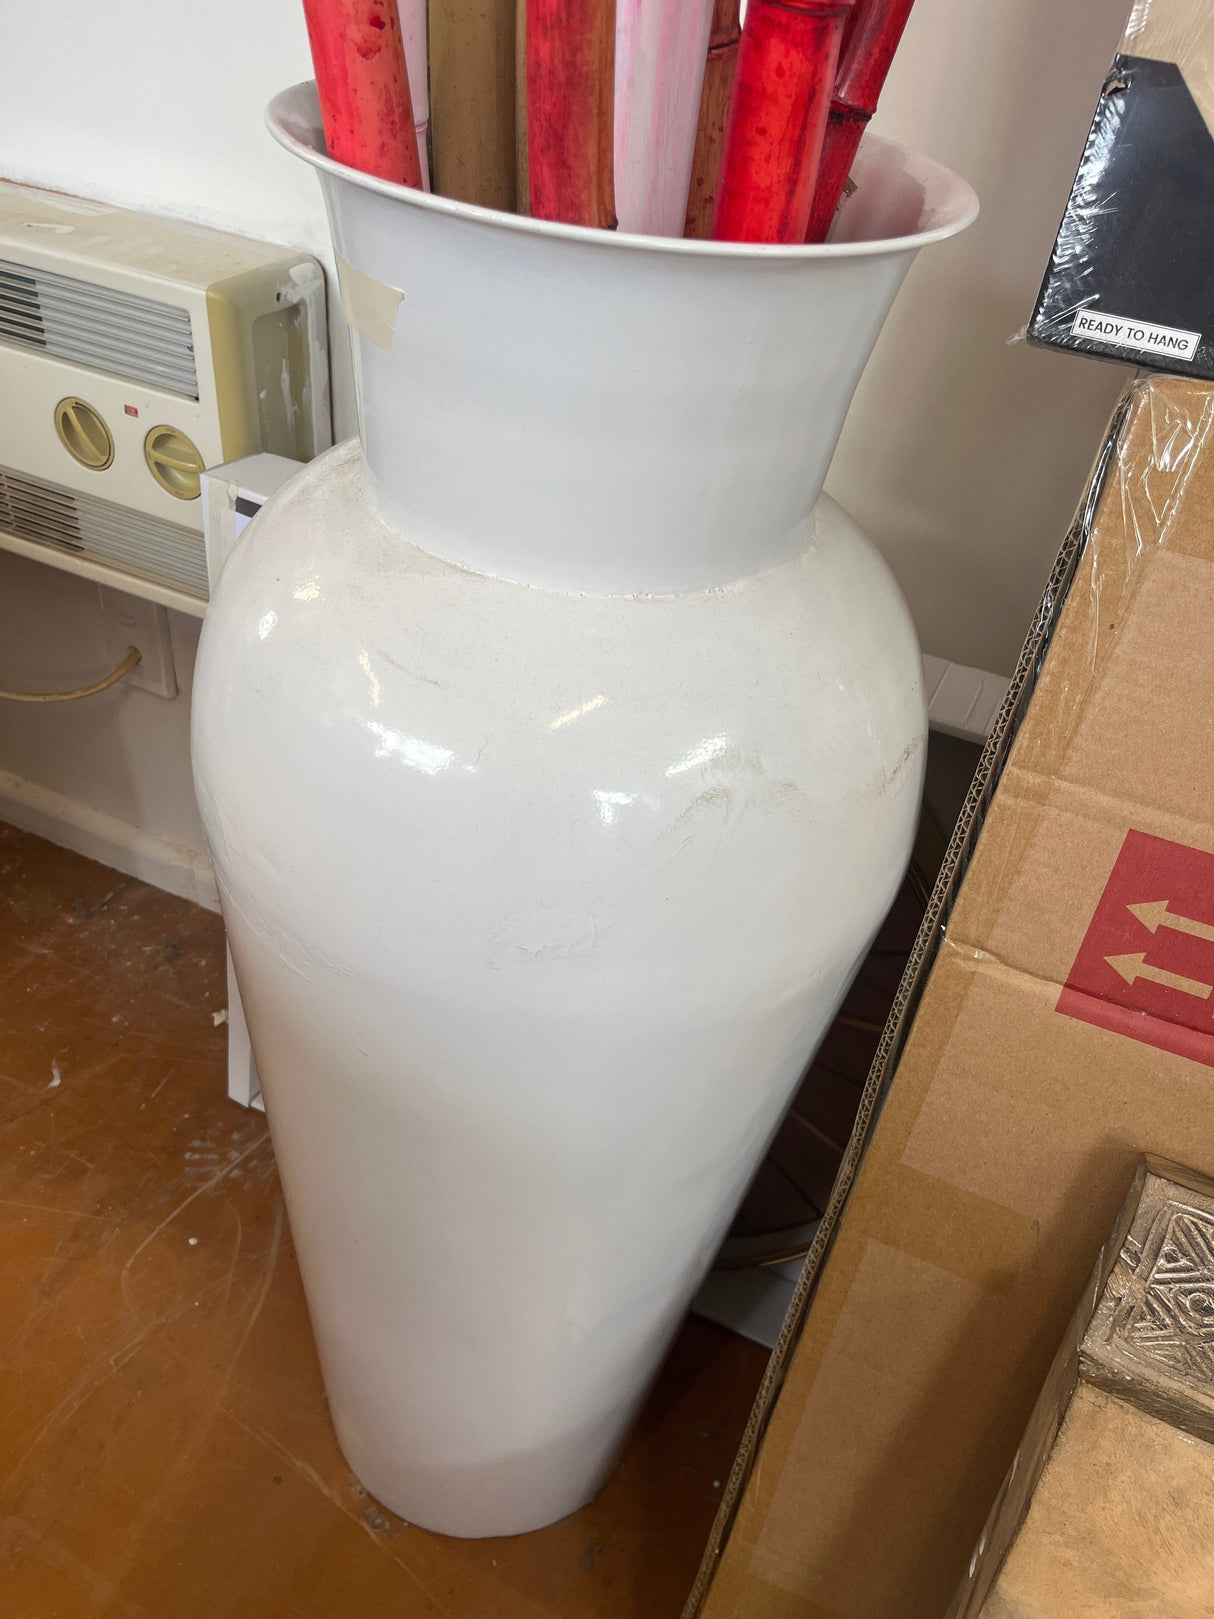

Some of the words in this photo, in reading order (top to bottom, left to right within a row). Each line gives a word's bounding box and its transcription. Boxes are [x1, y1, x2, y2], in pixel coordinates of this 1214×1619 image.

[1078, 317, 1123, 336] READY
[1126, 327, 1144, 341] TO
[1147, 332, 1189, 351] HANG
